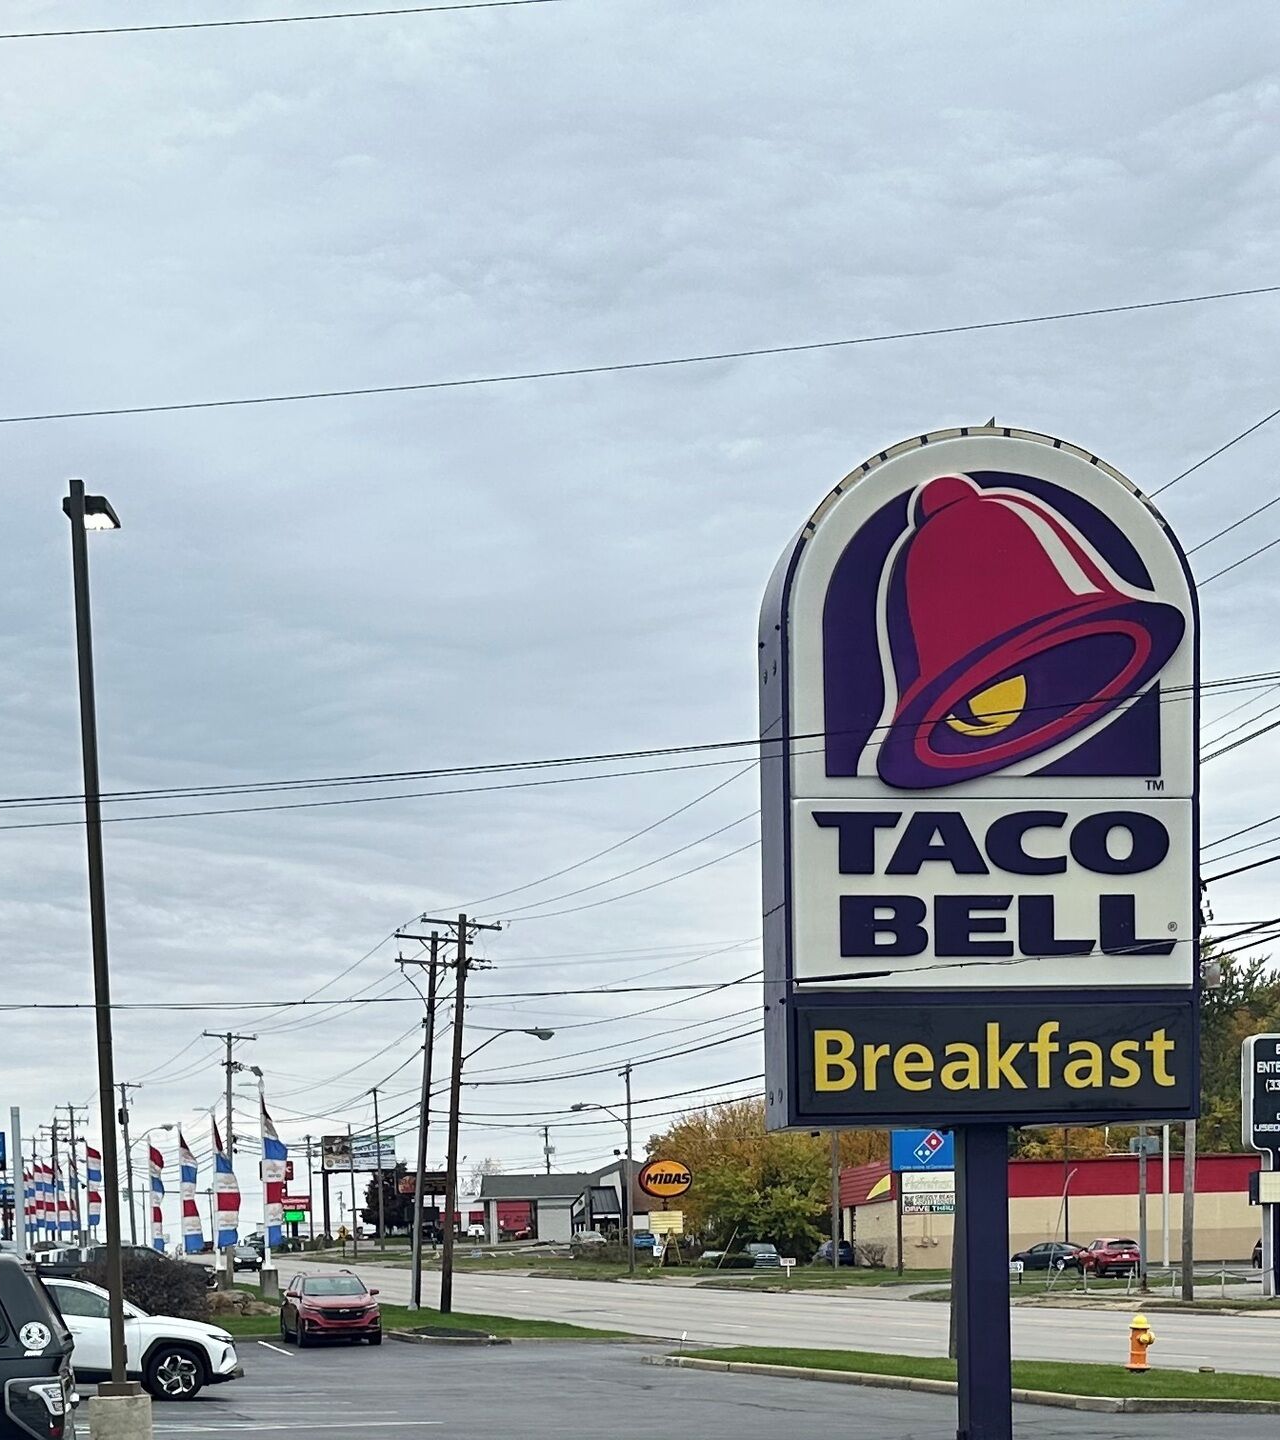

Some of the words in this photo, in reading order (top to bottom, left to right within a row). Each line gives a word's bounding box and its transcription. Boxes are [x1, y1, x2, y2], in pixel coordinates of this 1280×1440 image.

[1145, 780, 1165, 791] TM
[811, 810, 1171, 876] TACO
[839, 894, 1178, 958] BELL
[813, 1020, 1177, 1093] Breakfast
[1253, 1124, 1280, 1132] USED
[645, 1172, 690, 1186] MIDAS
